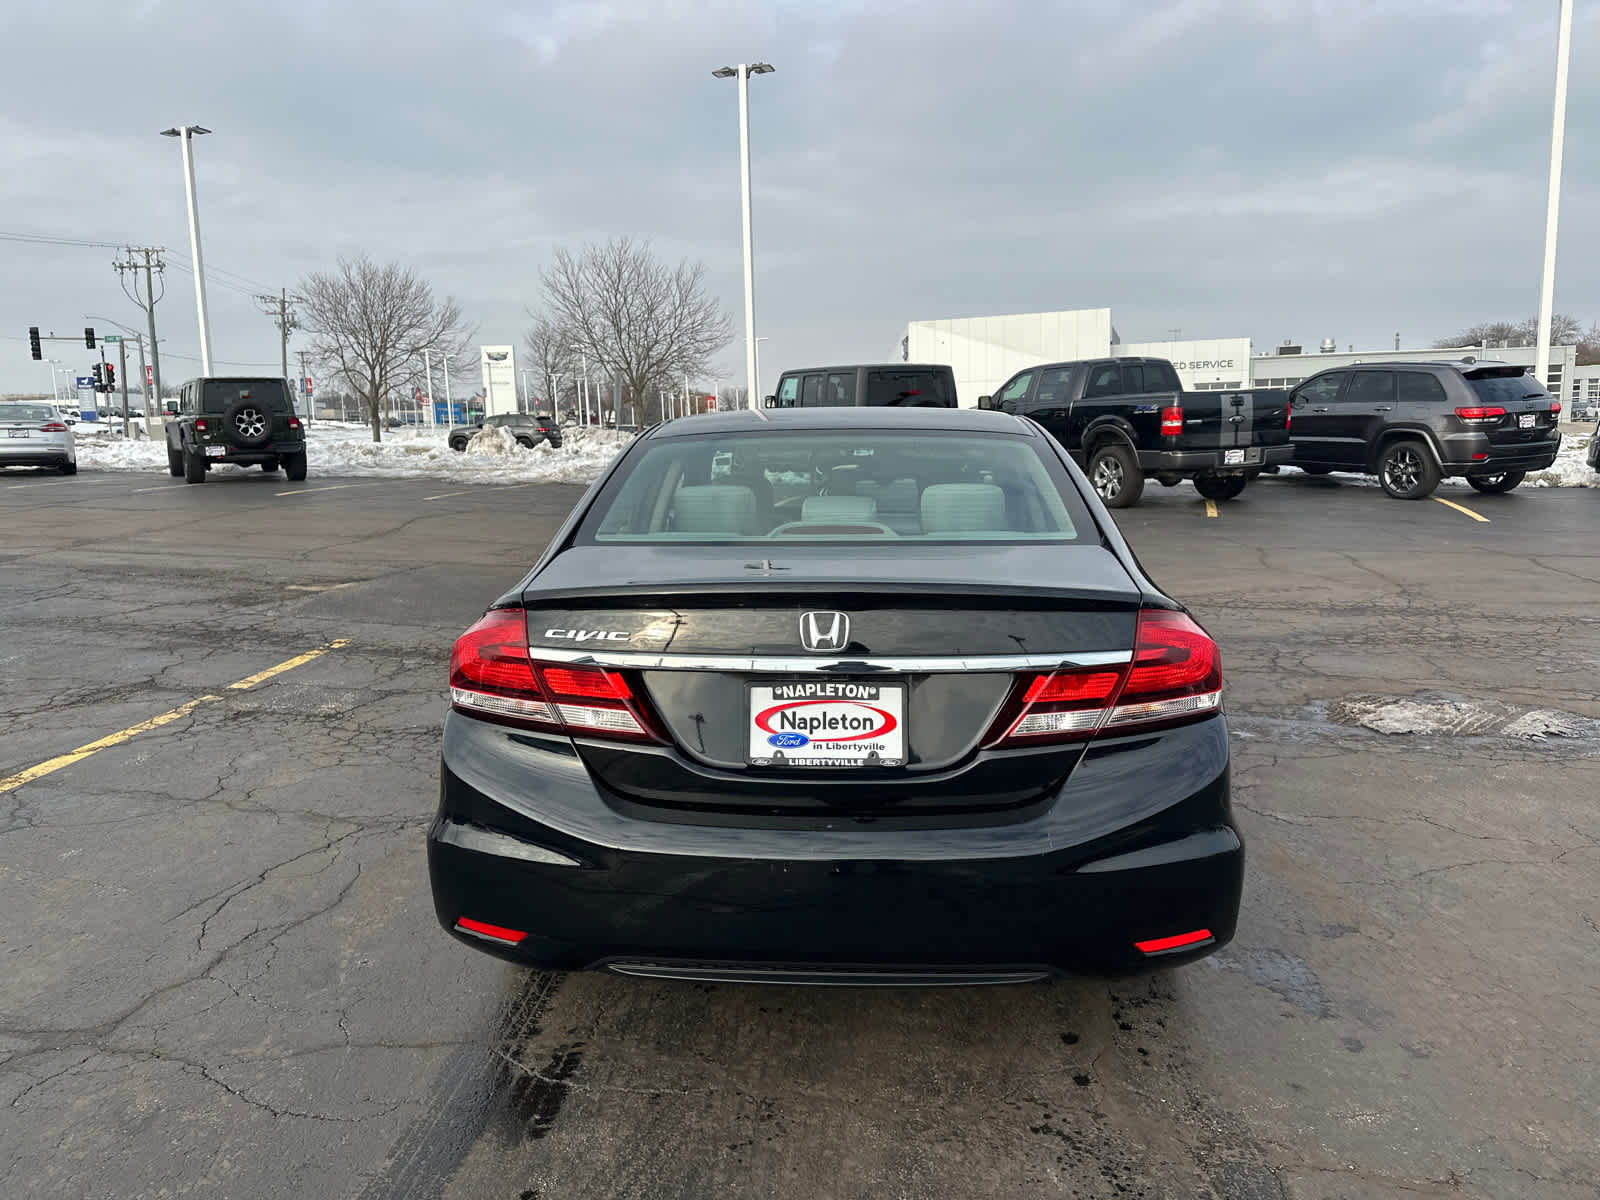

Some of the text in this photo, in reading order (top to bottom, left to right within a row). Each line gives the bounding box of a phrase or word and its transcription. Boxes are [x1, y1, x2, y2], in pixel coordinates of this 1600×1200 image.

[1189, 360, 1234, 370] SERVICE
[544, 629, 631, 642] CIVIC
[782, 683, 870, 699] NAPLETON
[780, 711, 874, 734] Napleton
[775, 735, 802, 746] Ford
[825, 742, 885, 752] Libertyville
